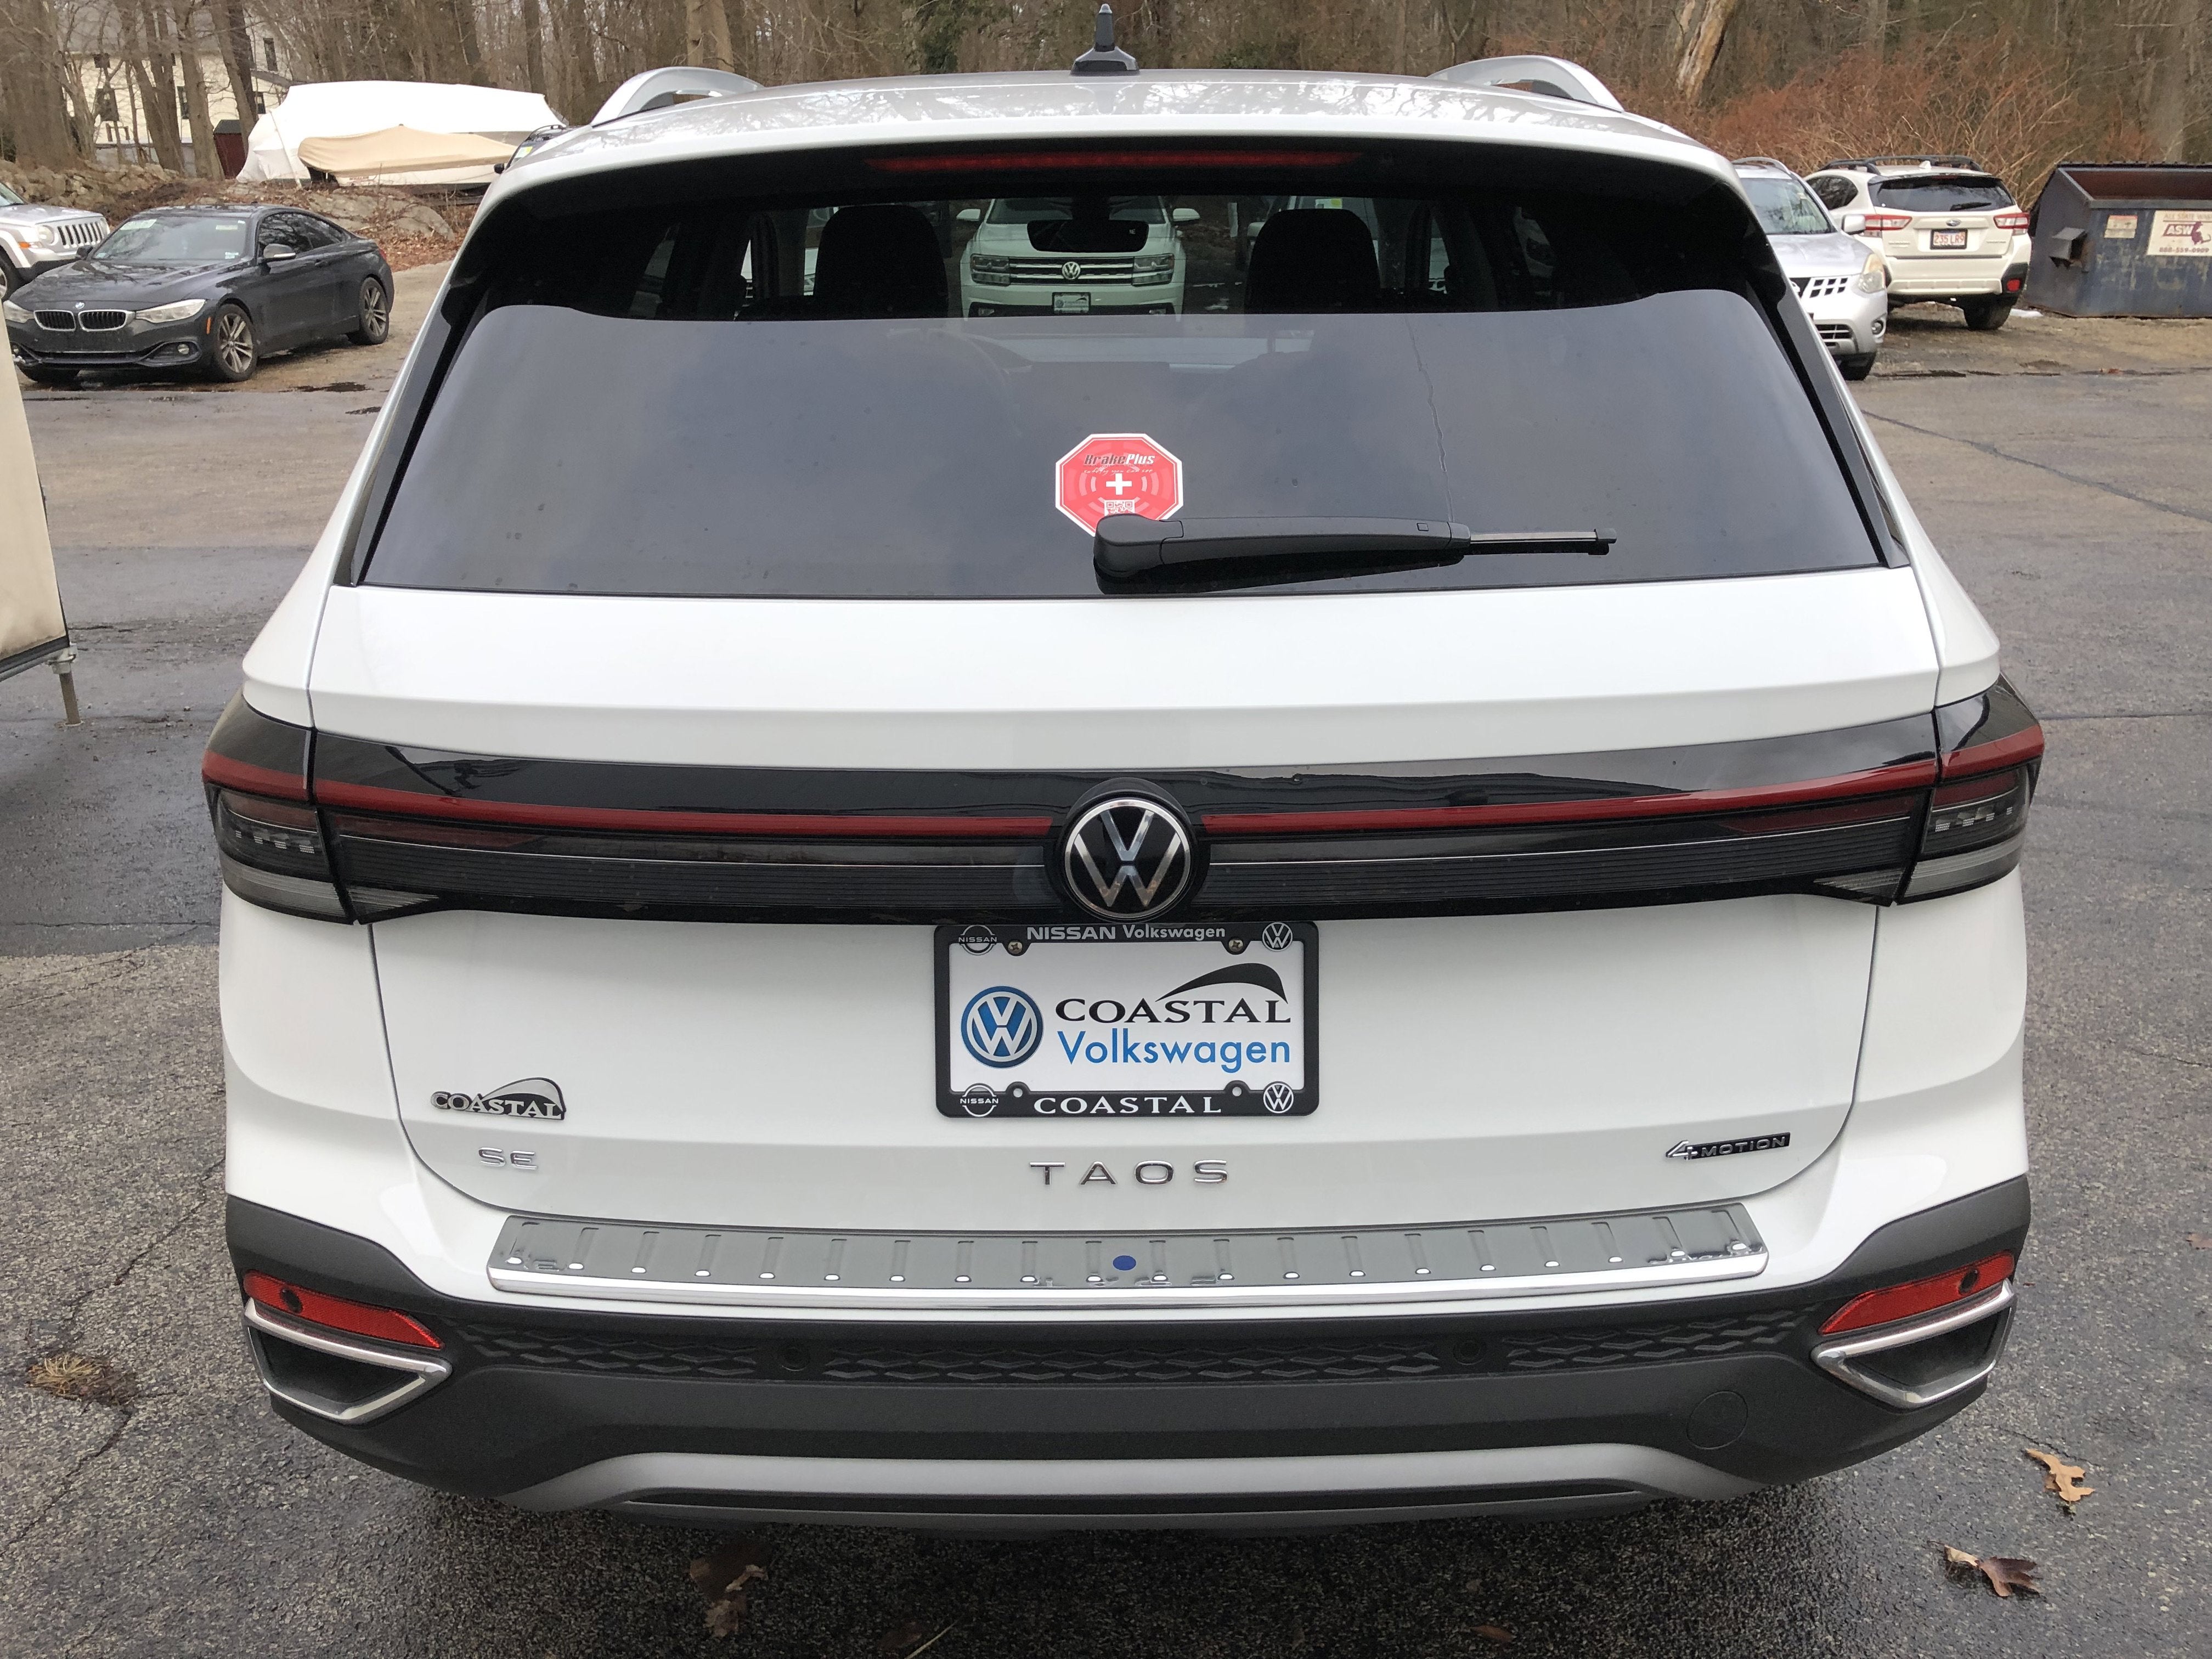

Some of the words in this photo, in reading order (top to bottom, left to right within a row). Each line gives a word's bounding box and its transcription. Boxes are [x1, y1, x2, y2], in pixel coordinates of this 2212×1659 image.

[1934, 235, 1948, 244] 235
[2166, 225, 2194, 235] ASW
[1069, 802, 1186, 913] VW
[1027, 927, 1116, 940] NISSAN
[1122, 924, 1226, 941] Volkswagen
[1263, 923, 1292, 950] VW
[1056, 998, 1291, 1023] COASTAL
[966, 991, 1039, 1063] VW
[1057, 1028, 1290, 1073] Volkswagen
[431, 1091, 562, 1120] COASTAL
[1034, 1096, 1221, 1114] COASTAL
[1264, 1084, 1293, 1113] VW
[478, 1147, 538, 1170] SE
[1666, 1136, 1786, 1160] 4MOTION
[1029, 1159, 1228, 1185] TAOS
